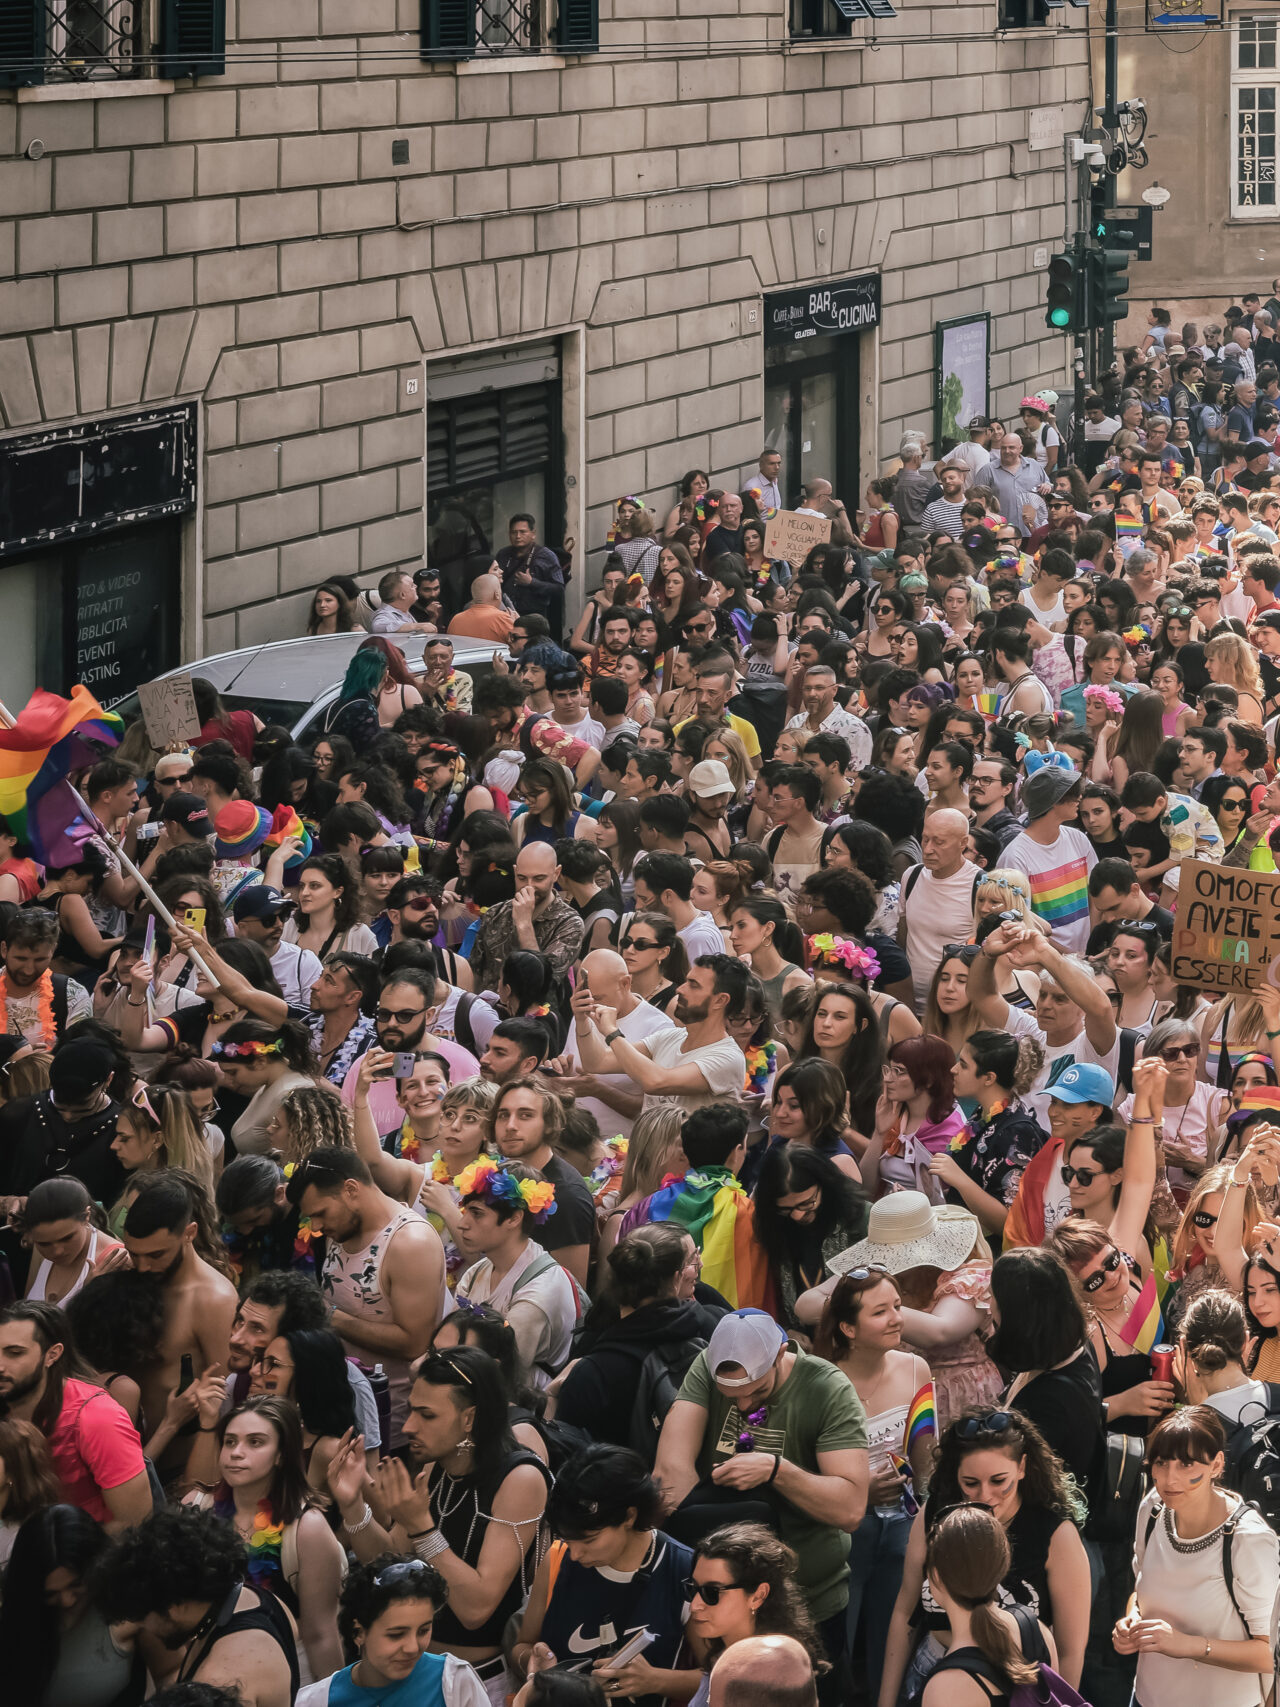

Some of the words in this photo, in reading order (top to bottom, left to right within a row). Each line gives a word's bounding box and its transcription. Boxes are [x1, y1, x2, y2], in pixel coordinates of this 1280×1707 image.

[1242, 113, 1254, 206] PALESTRA
[808, 290, 831, 315] BAR
[831, 301, 838, 319] &
[838, 302, 877, 329] CUCINA
[794, 328, 817, 339] GELATERIA
[787, 519, 815, 533] MELONI
[785, 542, 804, 552] SOLO
[108, 571, 141, 591] VIDEO
[77, 596, 124, 622] RITRATTI
[77, 640, 116, 664] EVENTI
[77, 661, 121, 685] ASTING
[1187, 901, 1263, 939] AVETE
[1178, 929, 1250, 964] PURA
[1258, 946, 1272, 964] di
[1173, 956, 1261, 989] ESSERE
